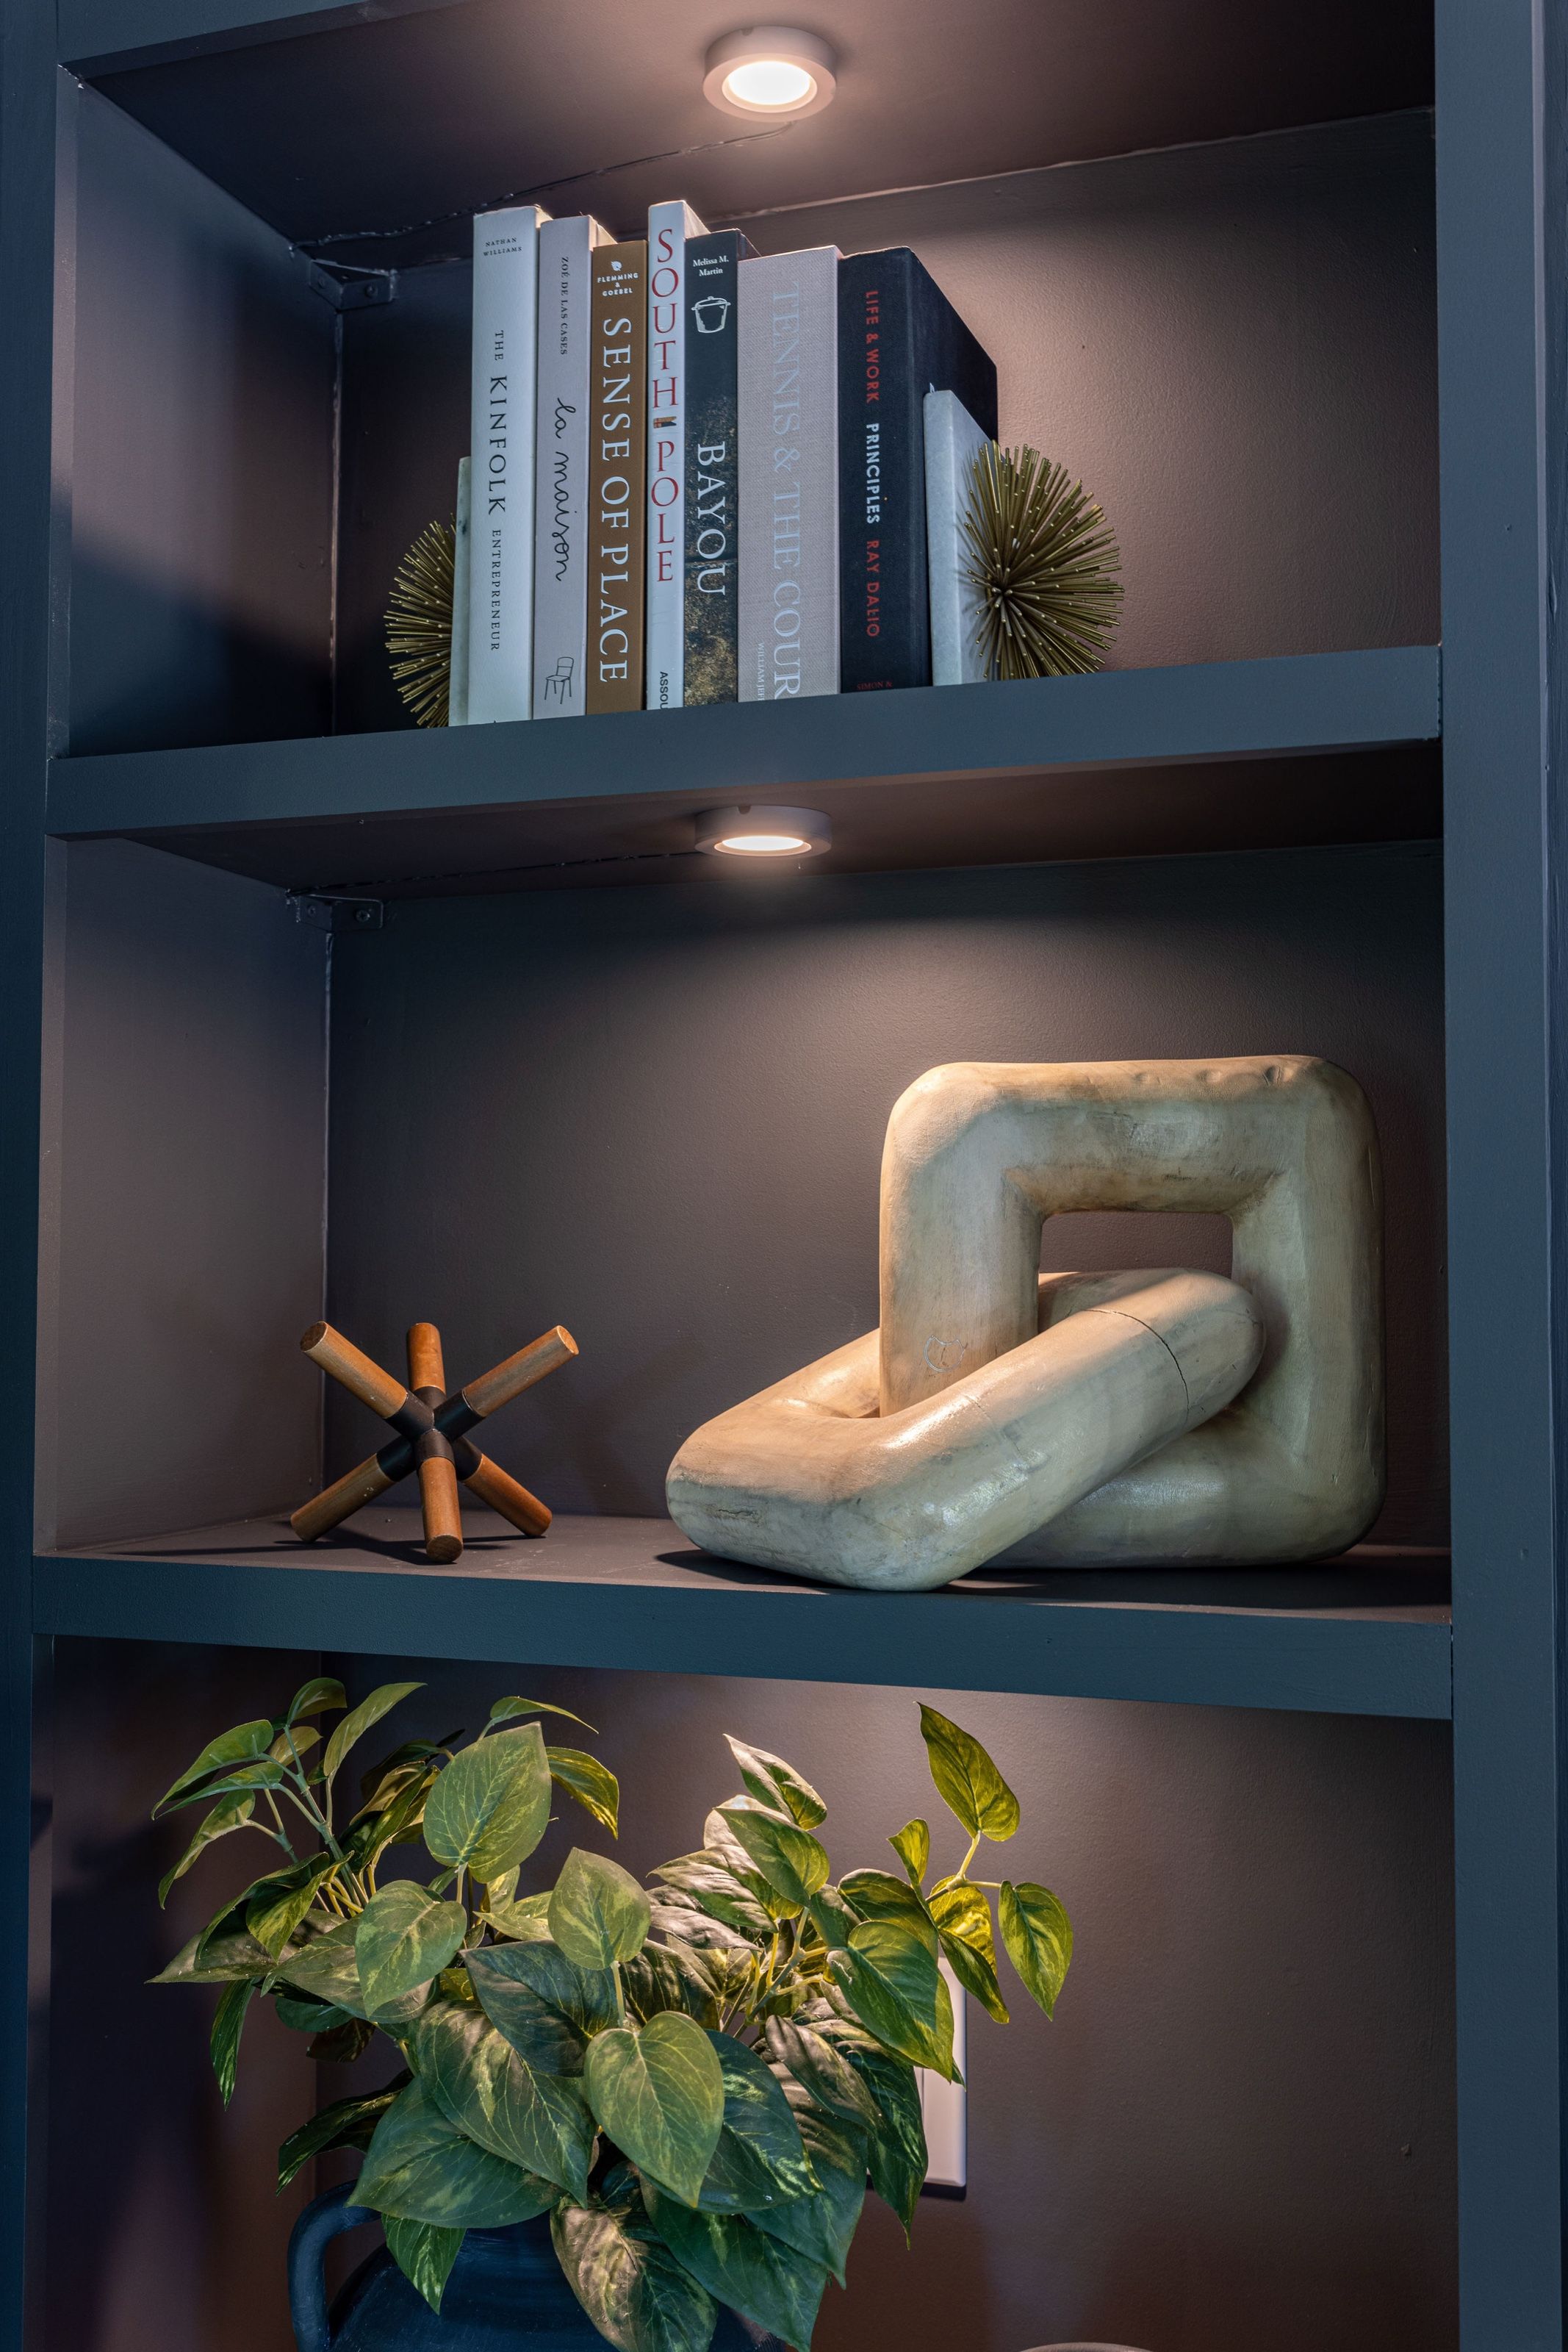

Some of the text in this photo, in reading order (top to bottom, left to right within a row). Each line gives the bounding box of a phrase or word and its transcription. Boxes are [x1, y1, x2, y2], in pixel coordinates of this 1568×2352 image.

[483, 246, 522, 257] WILLIAMS
[485, 237, 517, 248] NATHAN
[561, 257, 570, 279] ZOÉ
[693, 255, 729, 267] Melissa M.
[699, 267, 723, 276] Martin
[561, 281, 569, 296] DE
[597, 273, 639, 284] FLEMMING
[602, 287, 633, 297] GOEBEL
[561, 299, 569, 319] LAS
[866, 291, 880, 404] LIFE & WORK
[651, 229, 679, 582] SOUTH POLE
[866, 423, 880, 525] PRINCIPLES
[489, 330, 507, 651] THE KINFOLK ENTREPRENEUR
[600, 318, 632, 683] SENSE OF PLACE
[772, 281, 801, 699] TENNIS & THE COUR
[552, 451, 578, 581] maison
[697, 441, 727, 595] BAYOU
[866, 539, 880, 637] RAY DALIO
[857, 681, 883, 690] SIMON
